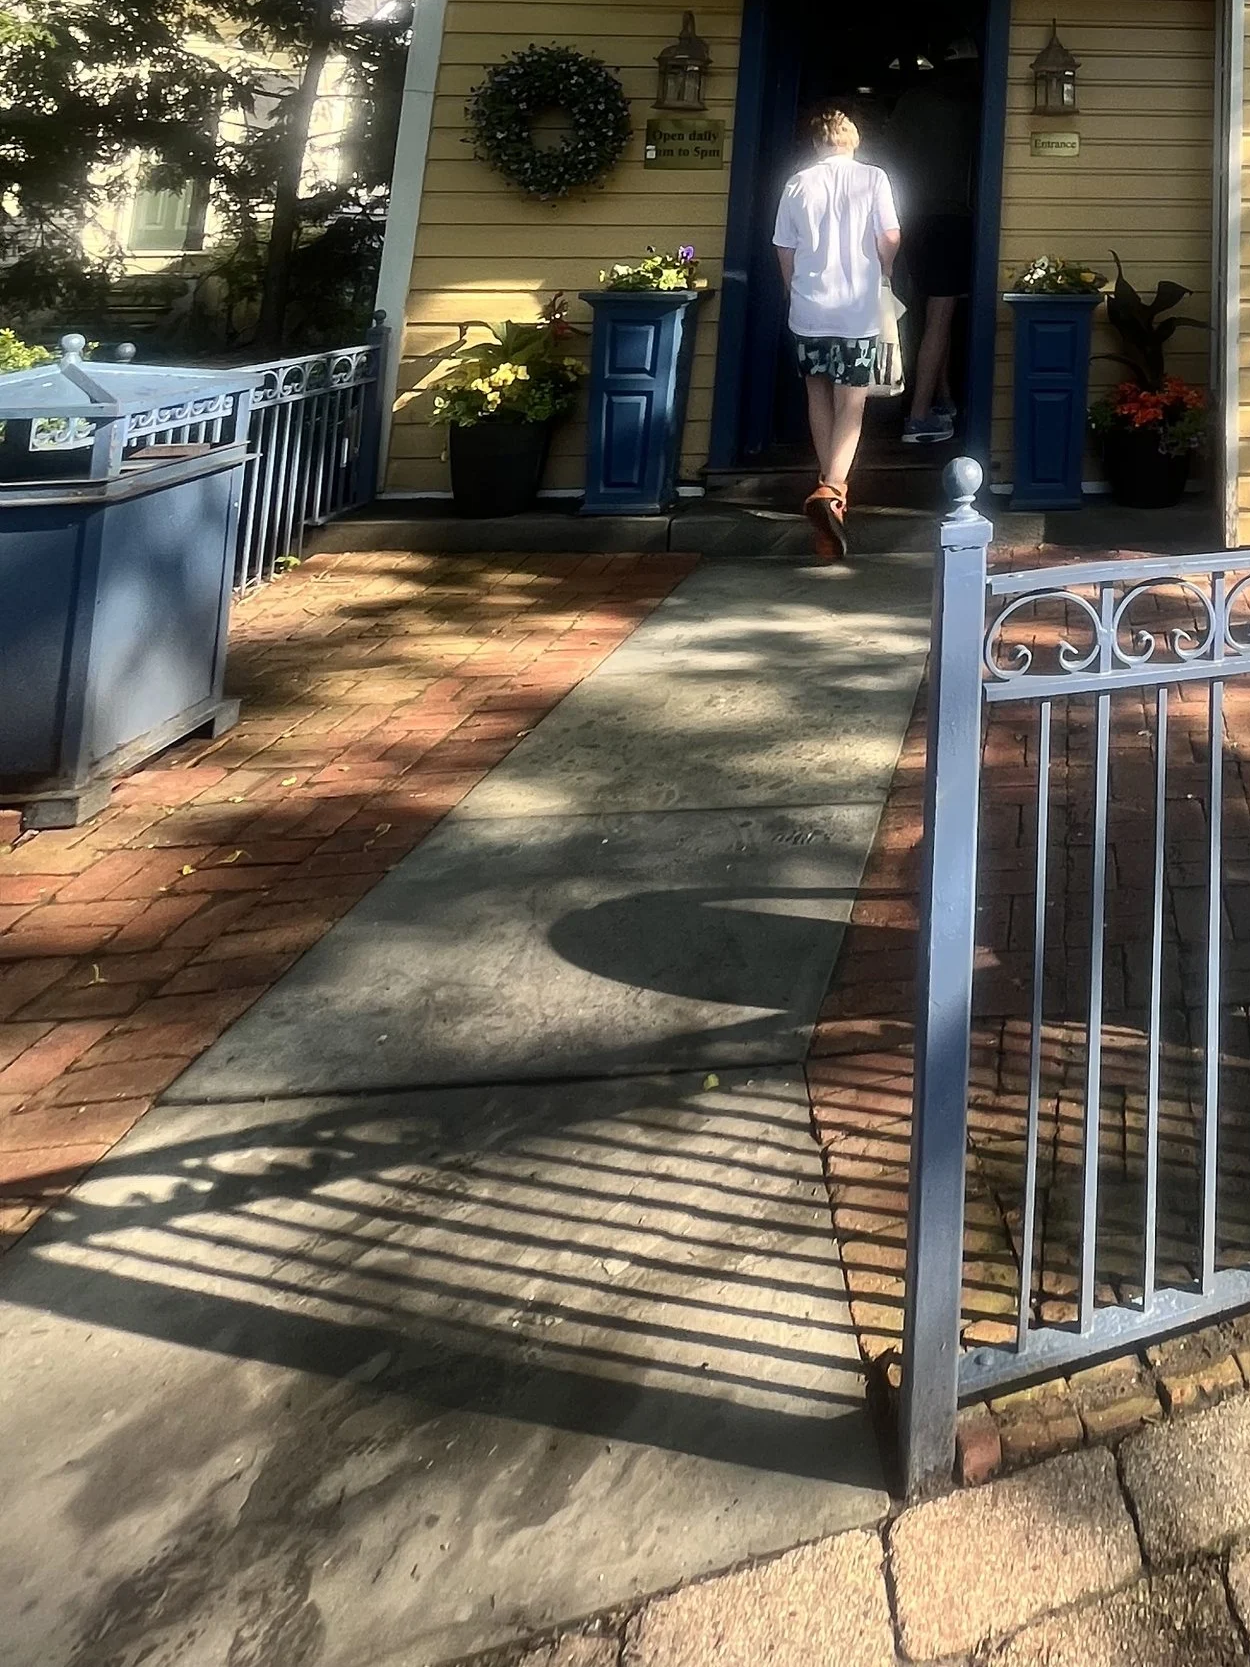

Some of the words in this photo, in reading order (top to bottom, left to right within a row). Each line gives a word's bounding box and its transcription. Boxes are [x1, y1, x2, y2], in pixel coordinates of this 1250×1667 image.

[652, 129, 685, 144] Open
[689, 129, 720, 144] daily
[1034, 138, 1077, 149] Entrance
[678, 147, 690, 157] to
[693, 146, 720, 160] 5pm
